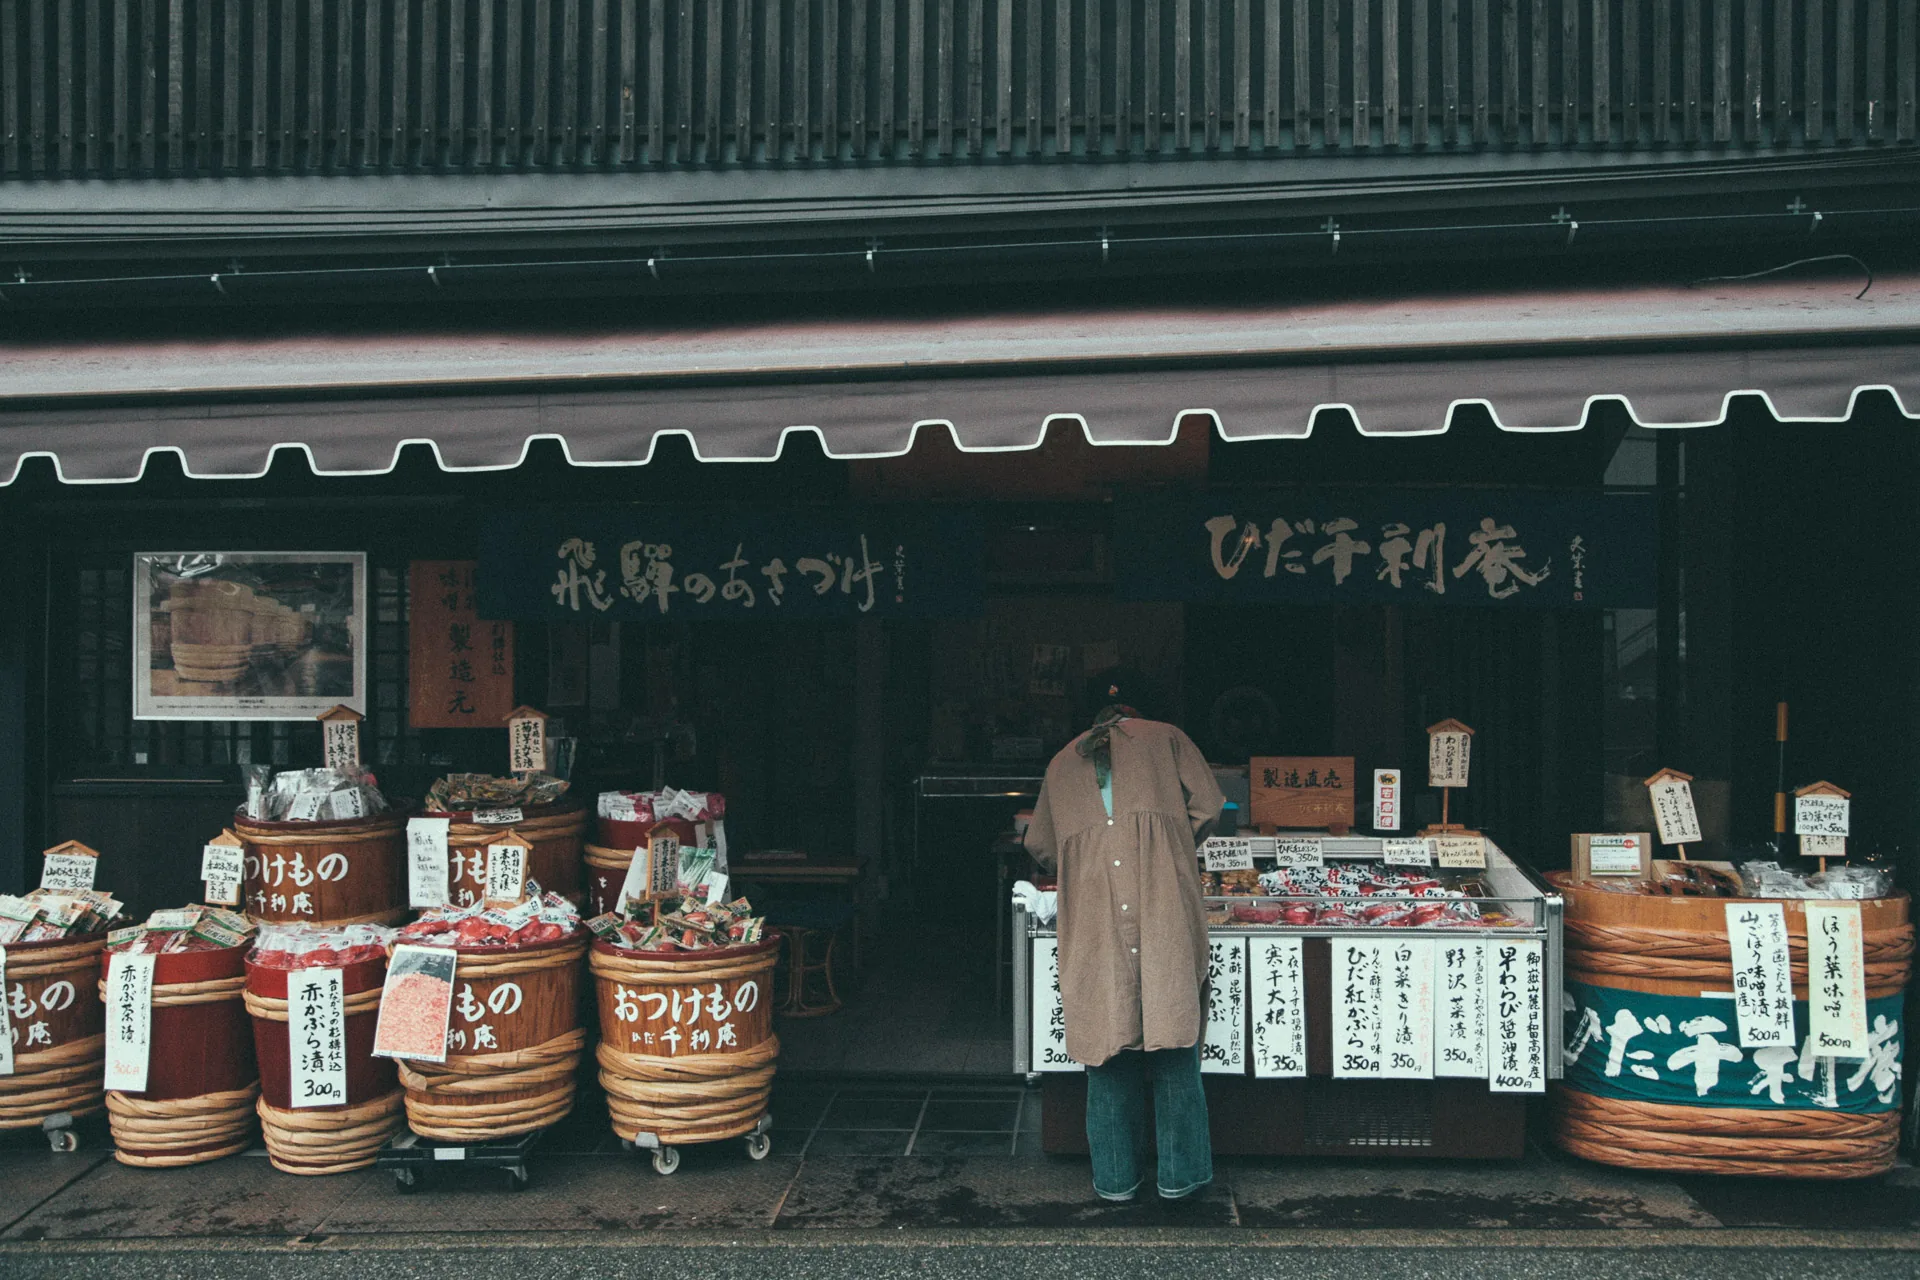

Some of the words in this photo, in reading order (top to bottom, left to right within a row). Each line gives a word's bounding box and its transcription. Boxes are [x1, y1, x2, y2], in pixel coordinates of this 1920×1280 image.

[1204, 514, 1551, 600] ひだ千利庵
[449, 622, 476, 713] 製造元
[1263, 767, 1343, 788] 製造直売
[1265, 943, 1286, 1025] 寒干大根
[1739, 910, 1771, 1018] 山ごぼう味噌漬
[1822, 915, 1845, 1018] ほう葉味噌
[119, 964, 137, 1043] 赤かぶ茶漬
[456, 982, 523, 1022] もの
[614, 980, 759, 1026] おつけもの
[1345, 946, 1369, 1048] ひだ紅かぶら
[1394, 942, 1414, 1046] 白菜きり漬
[1445, 947, 1467, 1040] 野沢菜漬
[1499, 946, 1522, 1072] 早わらび醤油漬
[301, 983, 326, 1073] 赤かぶら漬
[631, 1023, 738, 1055] ひだ千利庵
[1254, 1021, 1270, 1068] あさづけ
[1748, 1026, 1781, 1042] 500円
[1818, 1031, 1851, 1048] 500円
[1271, 1055, 1304, 1073] 350円
[1342, 1054, 1380, 1072] 350円
[1390, 1052, 1422, 1073] 350円
[1443, 1047, 1473, 1065] 350円
[304, 1079, 341, 1098] 300円
[1495, 1075, 1533, 1089] 400円
